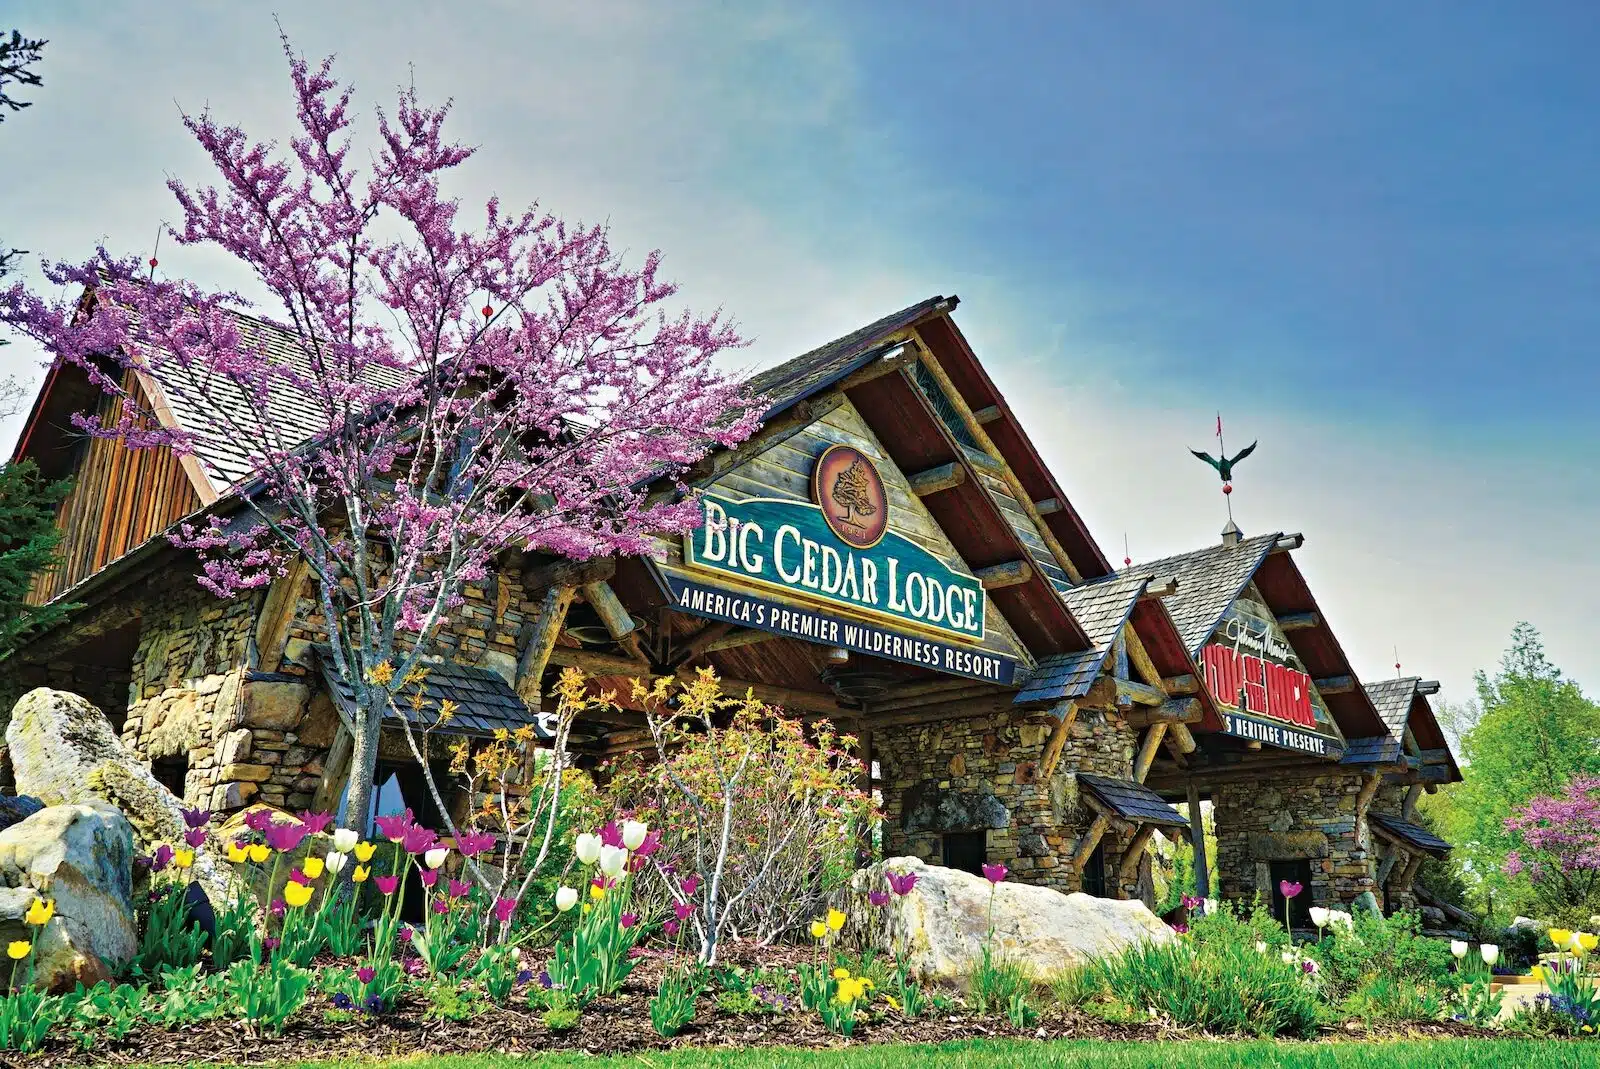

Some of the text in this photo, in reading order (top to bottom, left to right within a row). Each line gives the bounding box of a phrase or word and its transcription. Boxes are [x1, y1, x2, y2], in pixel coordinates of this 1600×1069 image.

[702, 499, 980, 631] BIG CEDAR LODGE
[680, 587, 1000, 680] AMERICA'S PREMIER WILDERNESS RESORT
[1263, 659, 1316, 730] ROCK
[1236, 718, 1280, 744] HERITAGE
[1282, 730, 1325, 754] PRESERVE
